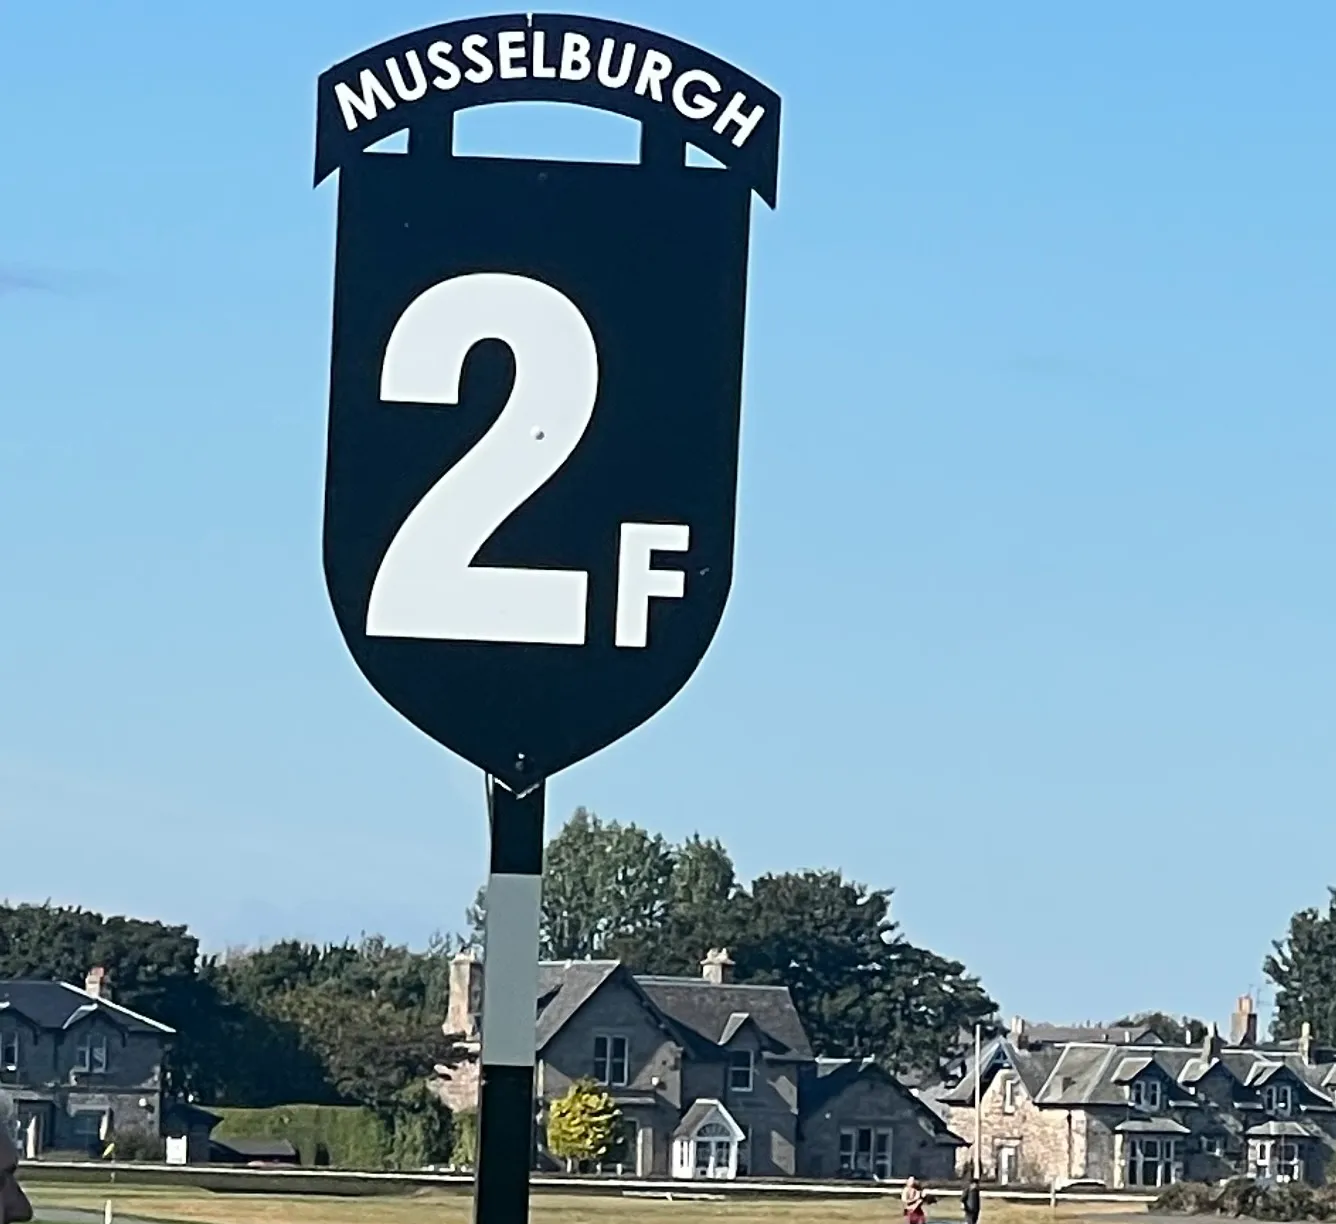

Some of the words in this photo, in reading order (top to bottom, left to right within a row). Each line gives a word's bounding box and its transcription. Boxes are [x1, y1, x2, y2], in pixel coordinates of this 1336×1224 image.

[334, 30, 765, 148] MUSSELBURGH
[366, 273, 598, 644] 2
[615, 523, 689, 647] F
